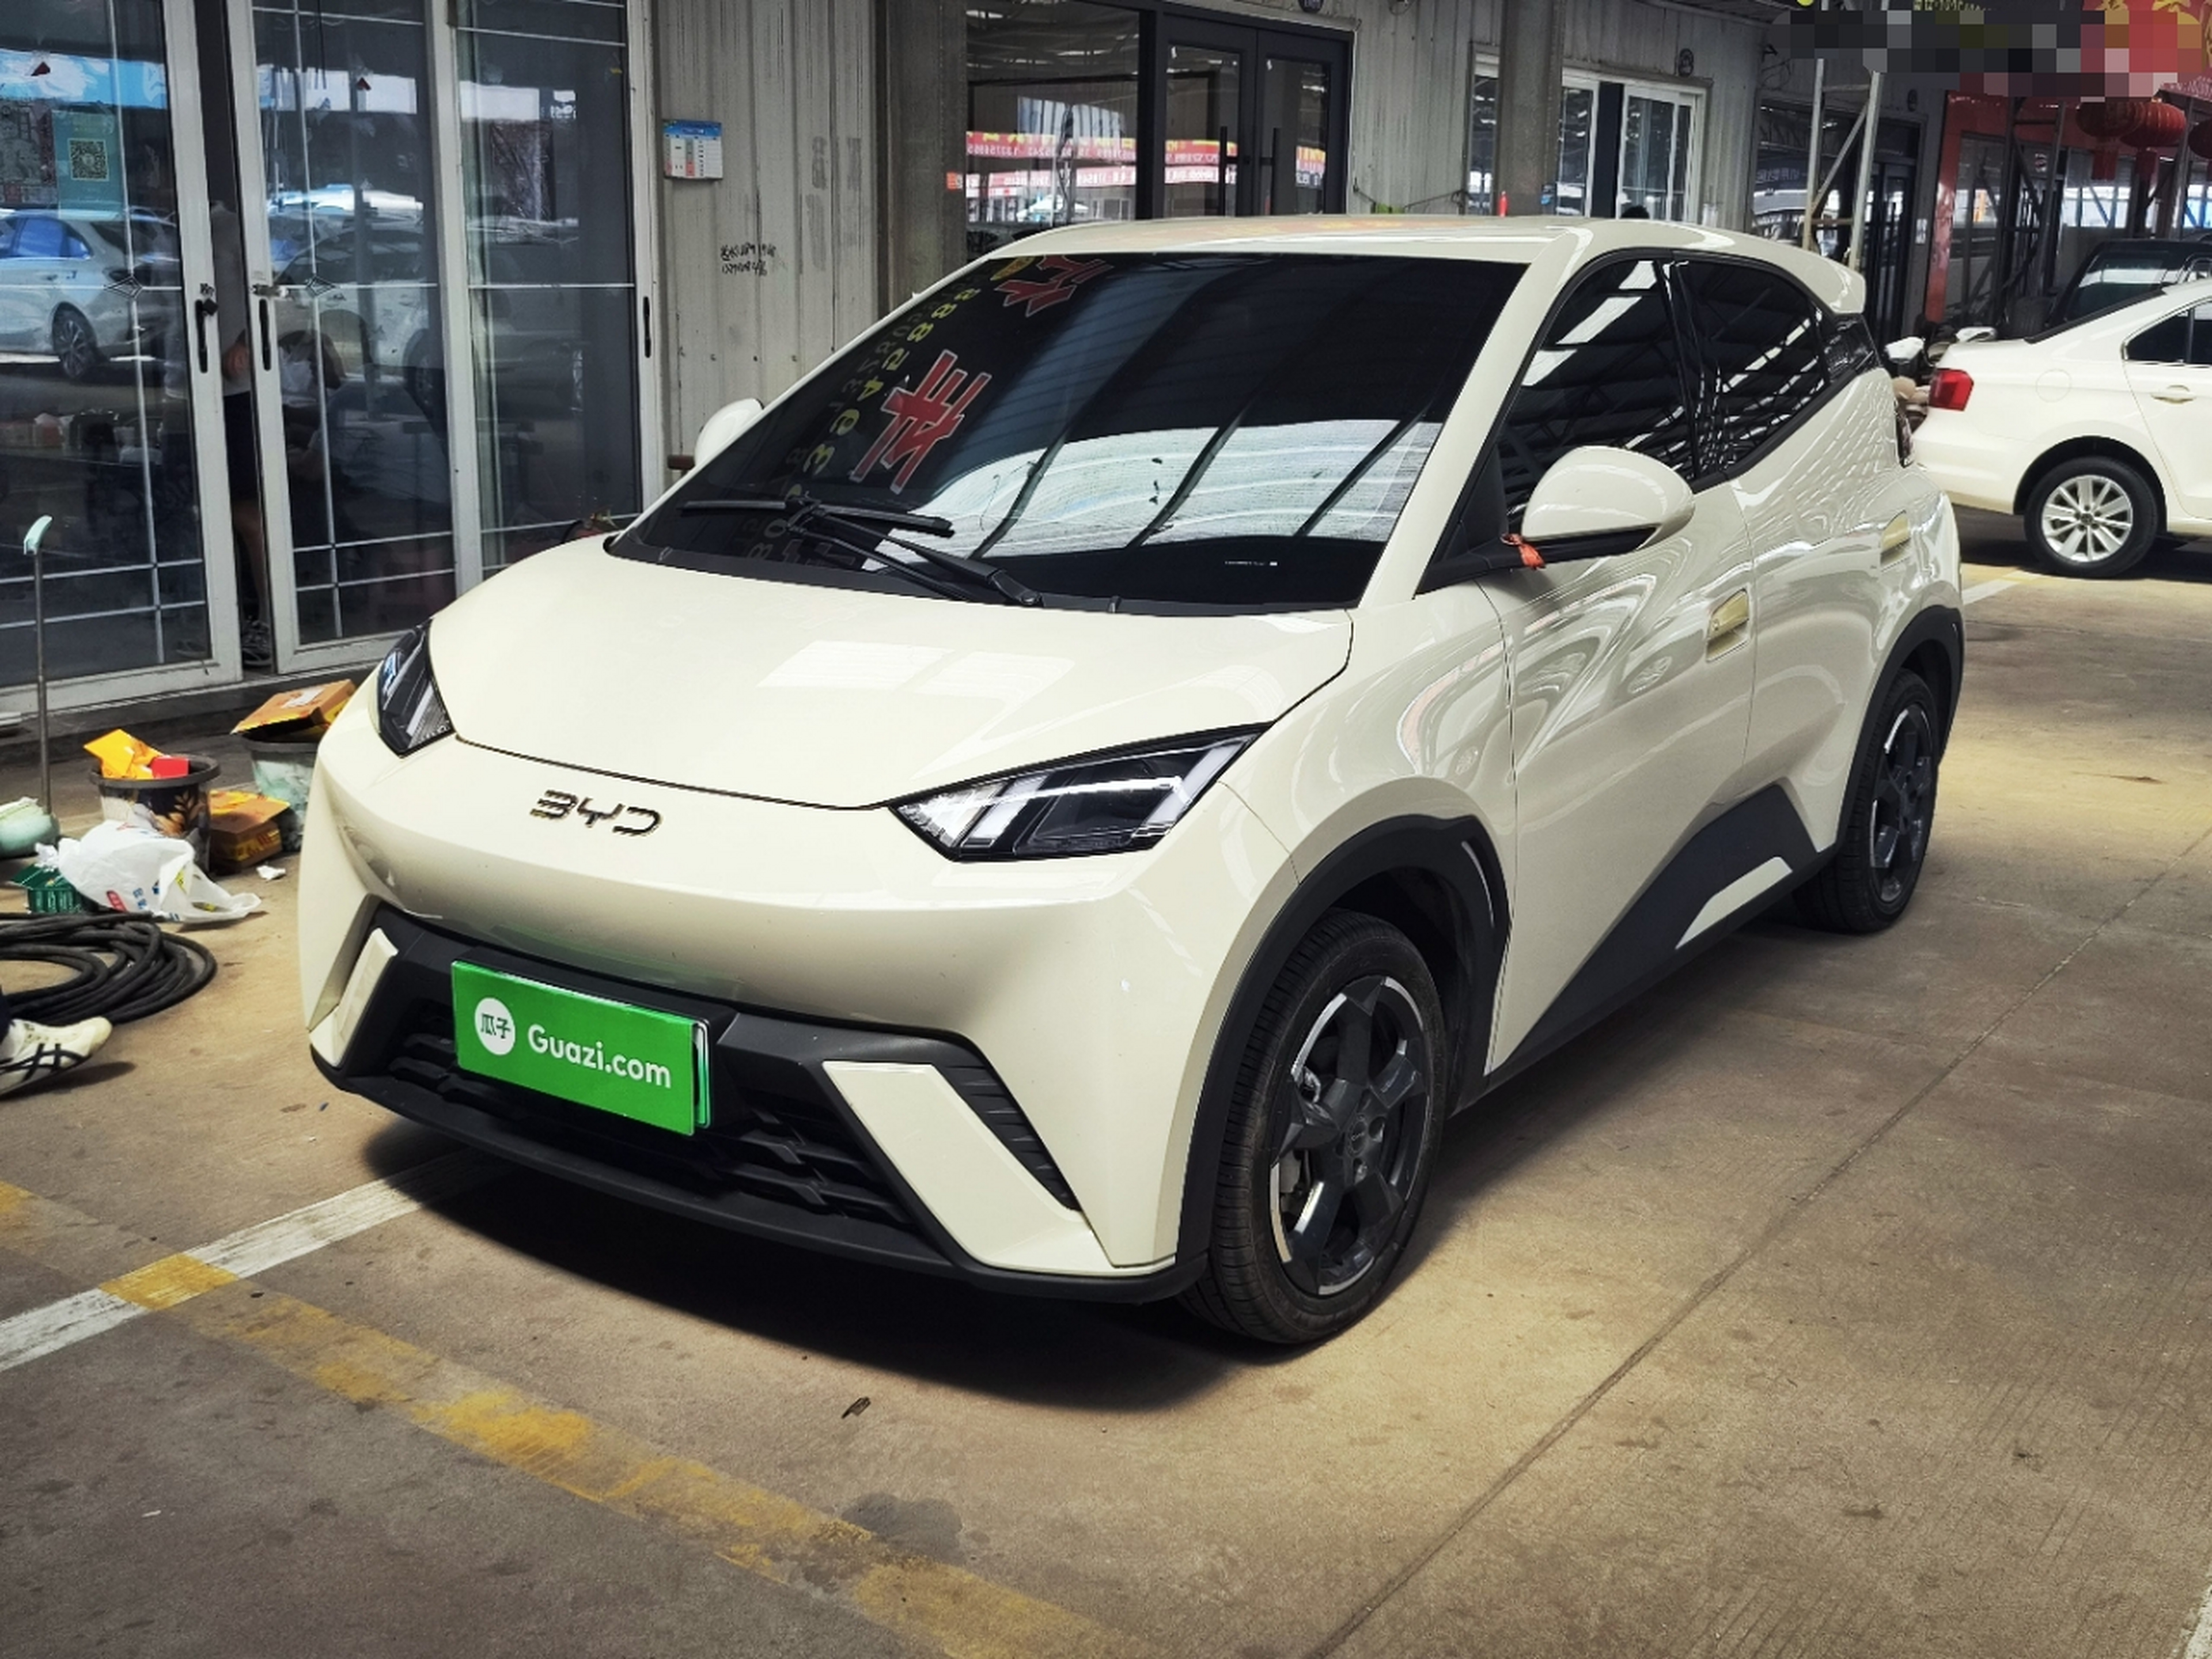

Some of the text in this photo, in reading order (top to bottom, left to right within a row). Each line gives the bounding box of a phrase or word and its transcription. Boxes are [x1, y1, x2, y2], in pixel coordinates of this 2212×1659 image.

[529, 789, 664, 836] BYD
[480, 1012, 512, 1041] 瓜子
[527, 1023, 672, 1089] Guazi.com
